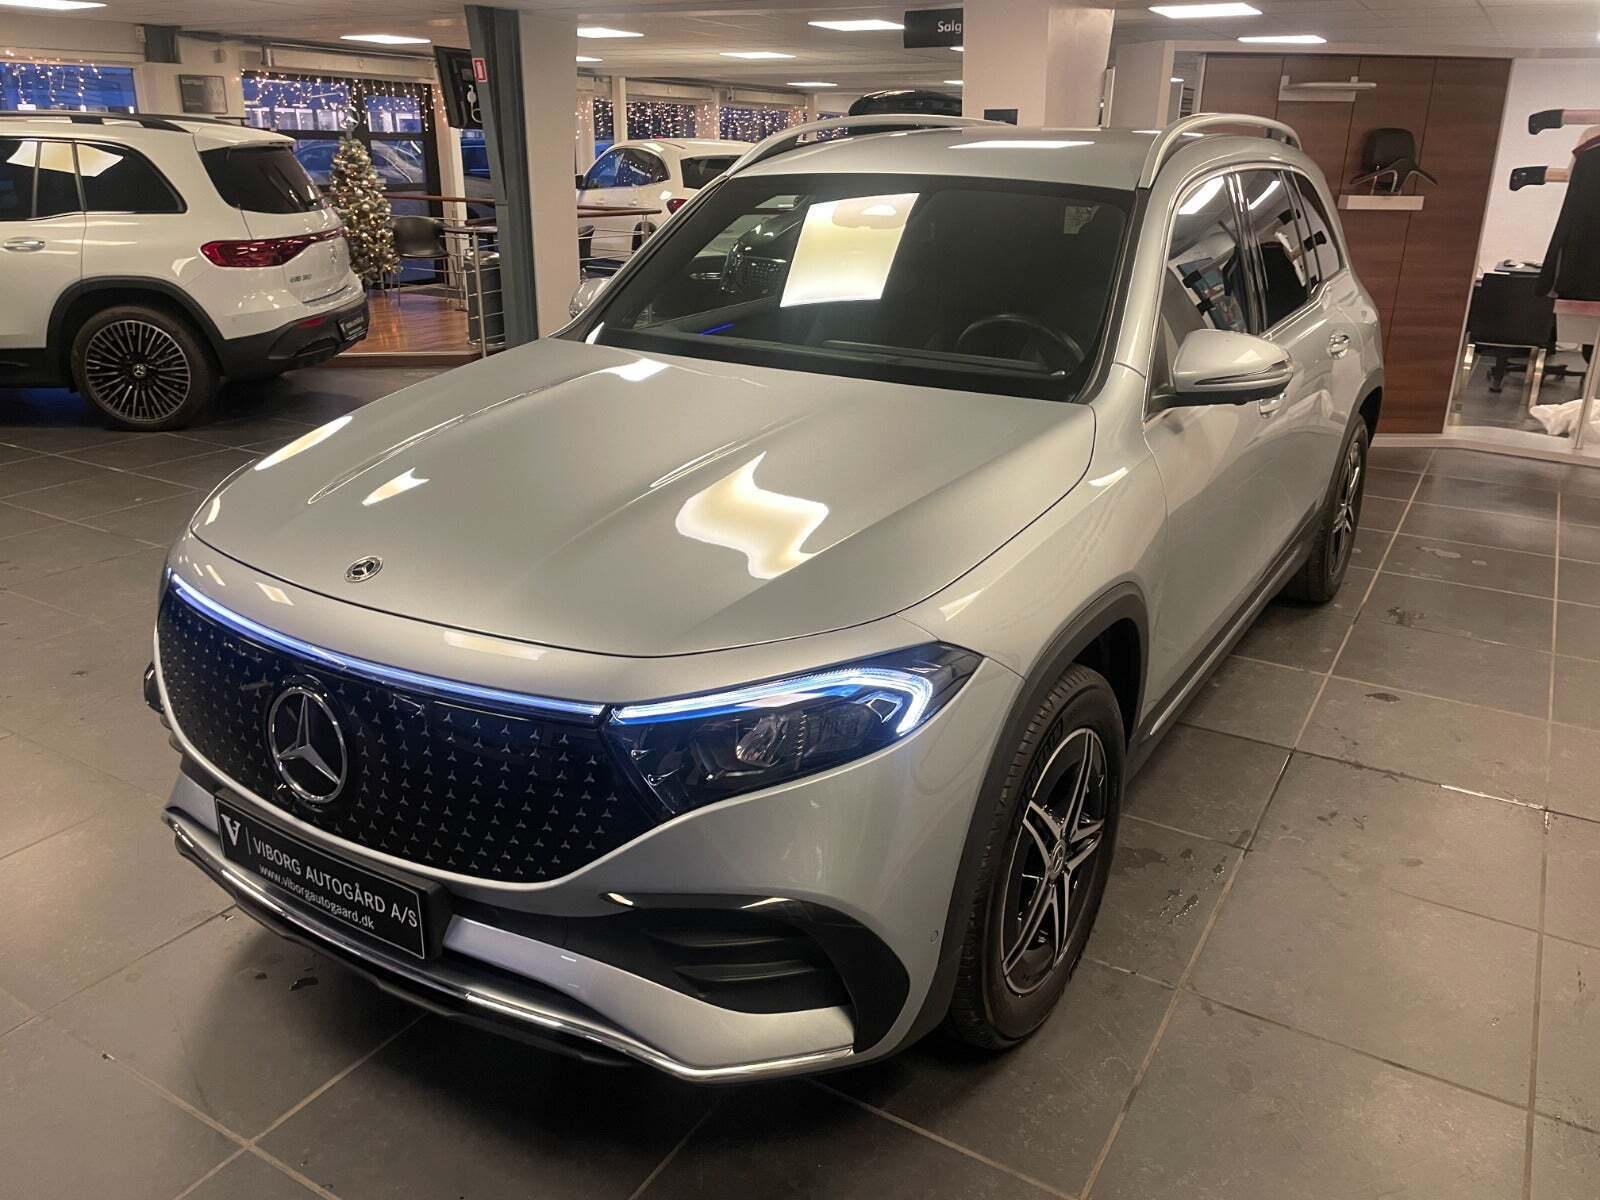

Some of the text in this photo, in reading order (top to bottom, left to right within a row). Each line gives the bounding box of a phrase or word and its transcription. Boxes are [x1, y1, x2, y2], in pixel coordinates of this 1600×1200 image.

[937, 20, 962, 34] Salg
[252, 836, 418, 928] VIBORG AUTOGÅRD A/S
[259, 863, 375, 930] www.viborgautogaard.dk
